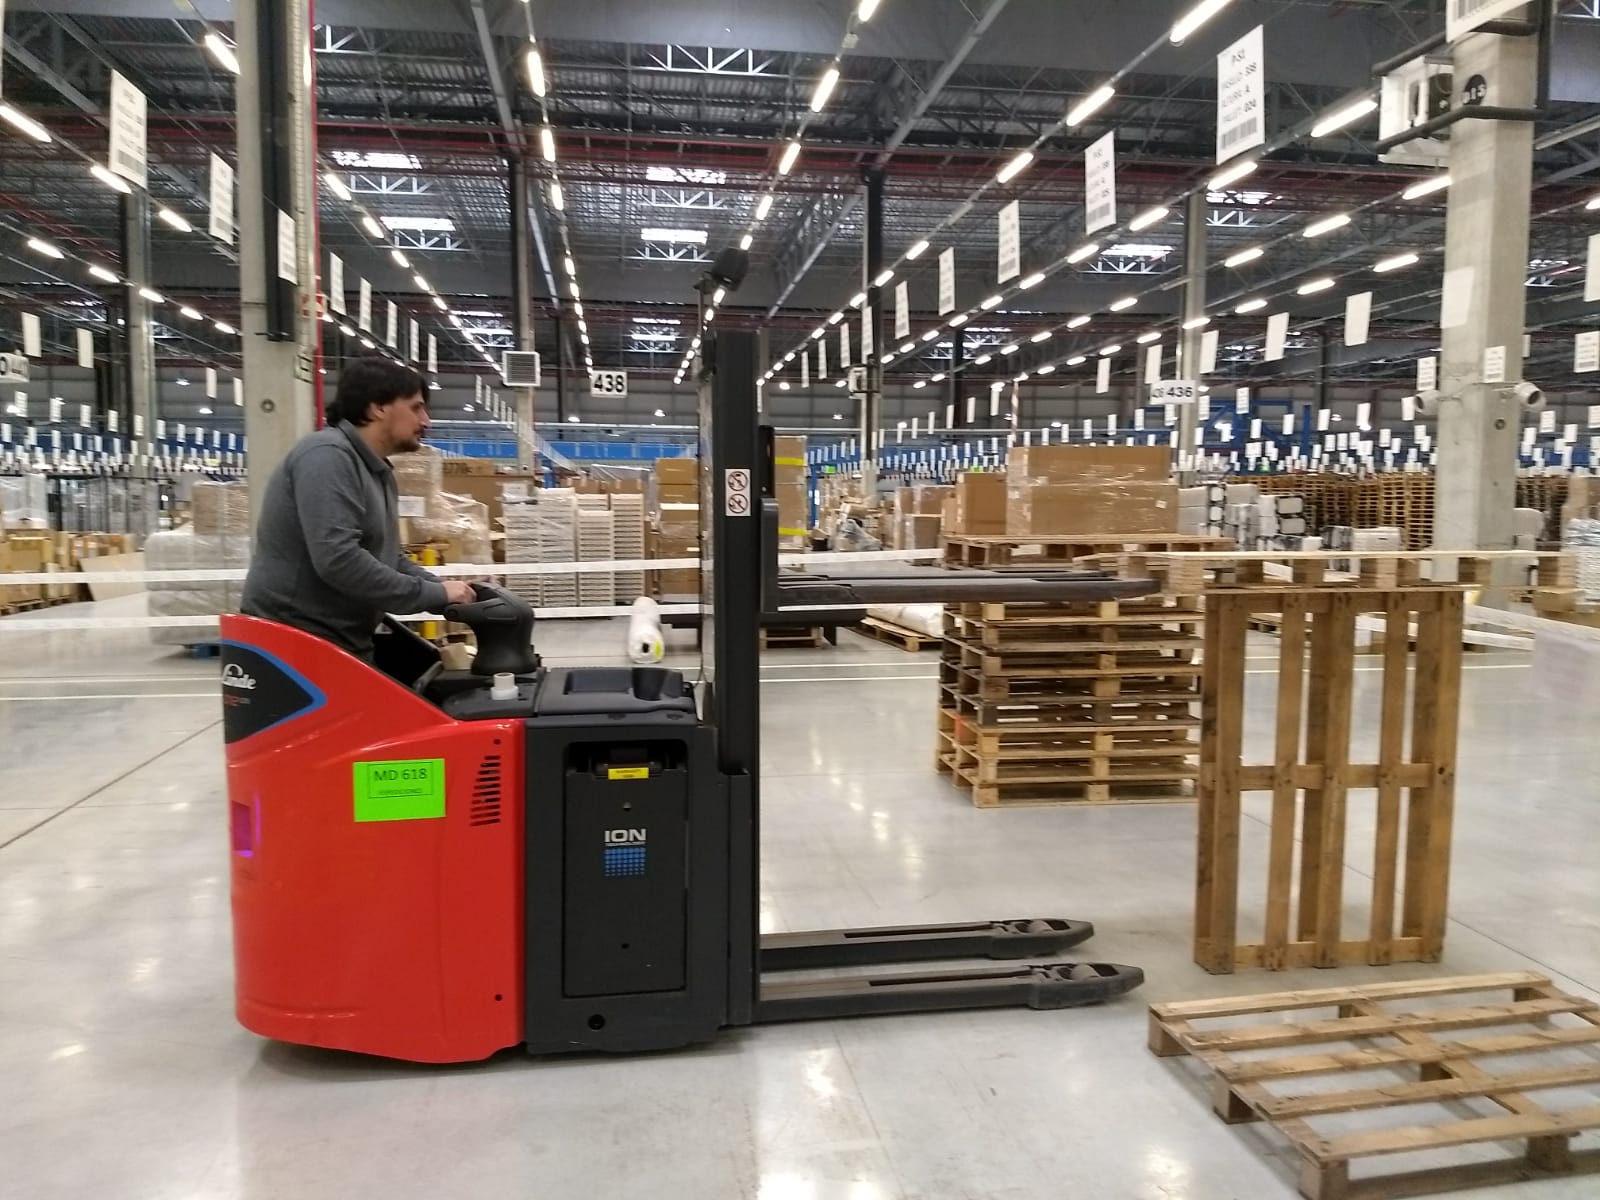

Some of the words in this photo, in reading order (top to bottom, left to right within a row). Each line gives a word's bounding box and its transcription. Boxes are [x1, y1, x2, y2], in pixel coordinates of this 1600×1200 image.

[594, 373, 624, 393] 438
[1167, 386, 1193, 398] 436
[374, 769, 399, 781] MD
[402, 767, 428, 780] 618
[604, 828, 647, 843] ION
